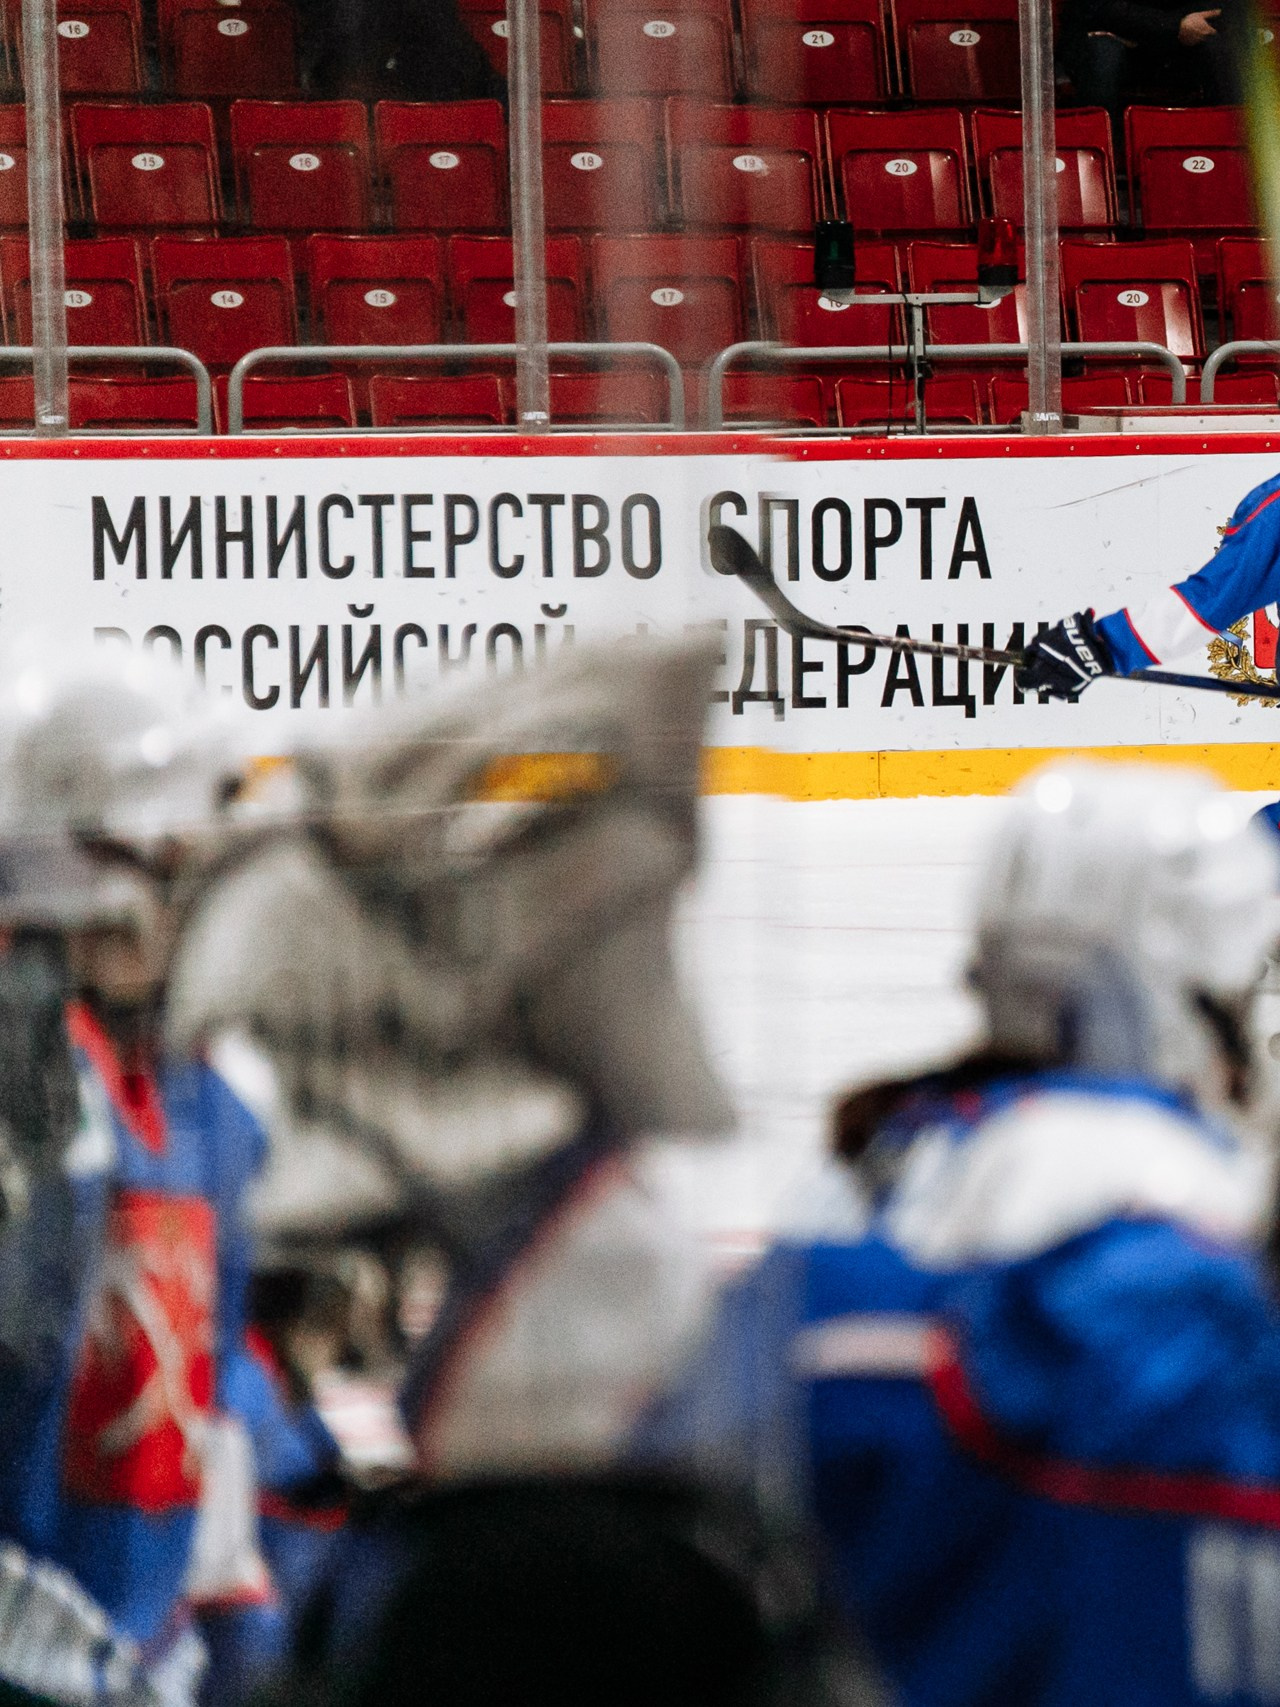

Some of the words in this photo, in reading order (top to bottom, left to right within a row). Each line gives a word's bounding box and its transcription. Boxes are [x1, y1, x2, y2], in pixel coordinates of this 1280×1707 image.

[91, 492, 662, 580] МИНИСТЕРСТВО
[702, 490, 992, 582] СПОРТА
[618, 619, 1080, 722] ДЕРАЦИ
[1063, 616, 1103, 676] AUER
